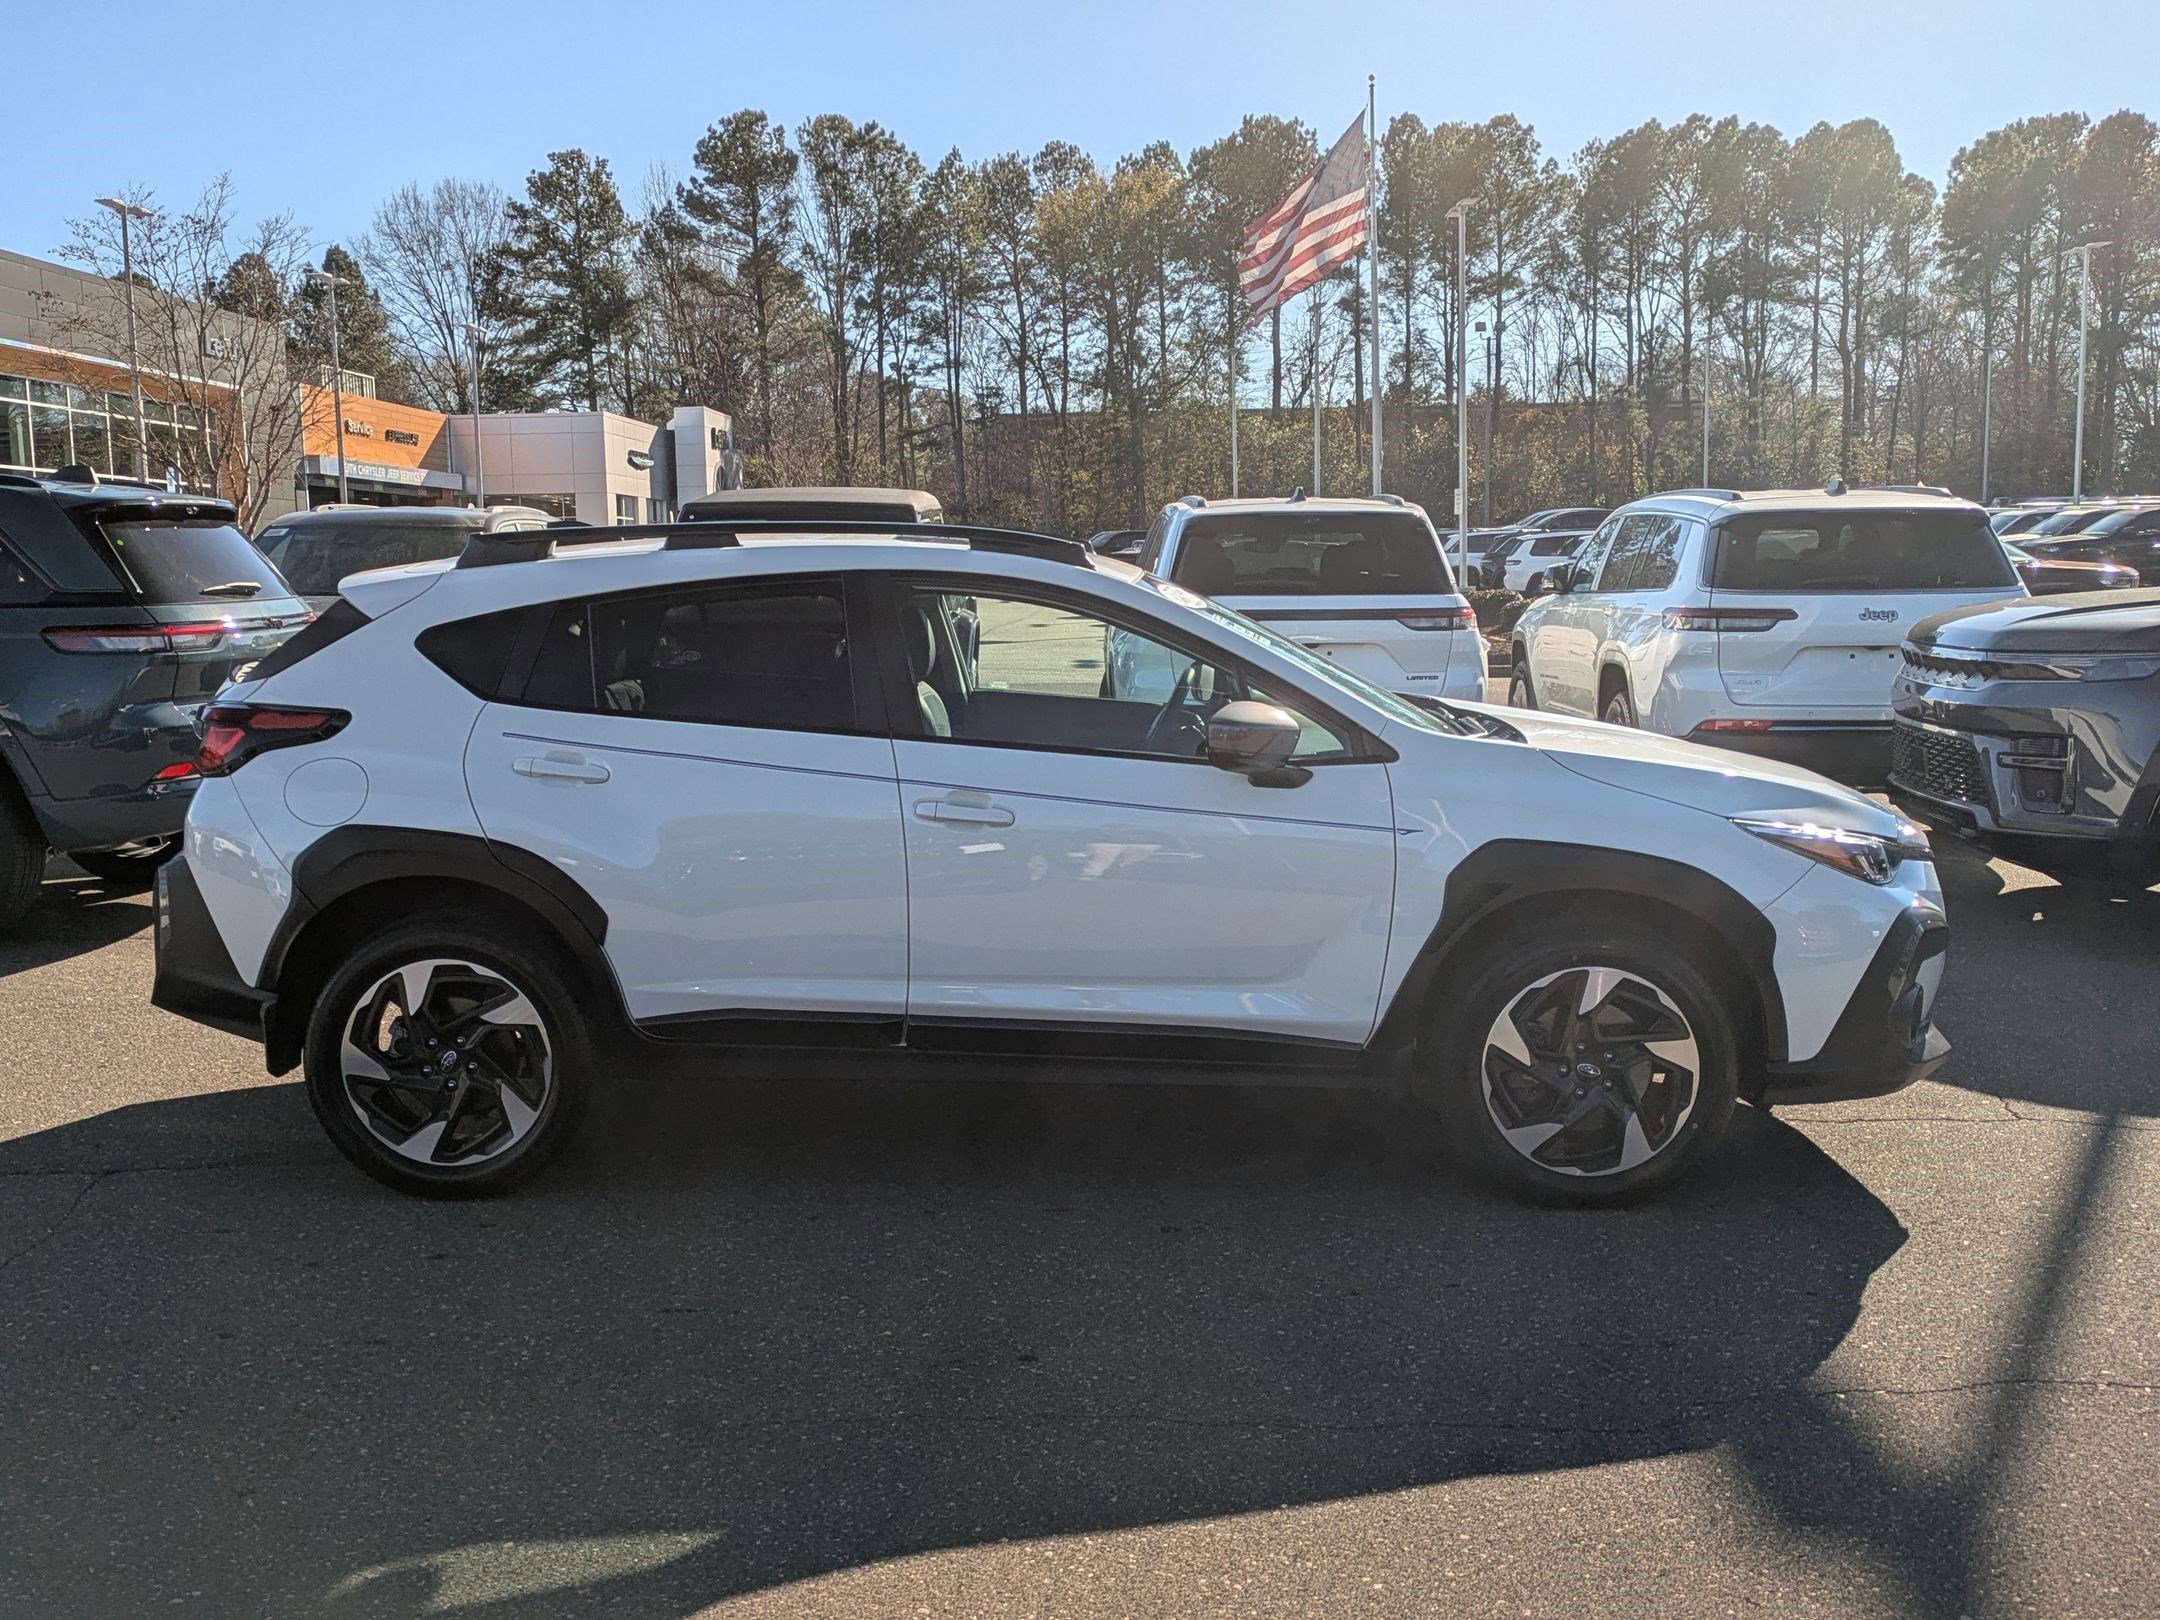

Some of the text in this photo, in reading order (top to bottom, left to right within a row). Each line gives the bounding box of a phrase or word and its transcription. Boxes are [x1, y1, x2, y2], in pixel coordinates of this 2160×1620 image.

[358, 464, 385, 478] CHRYSLER
[387, 468, 400, 480] JEEP
[400, 470, 420, 481] SERVICE
[1858, 607, 1898, 623] Jeep
